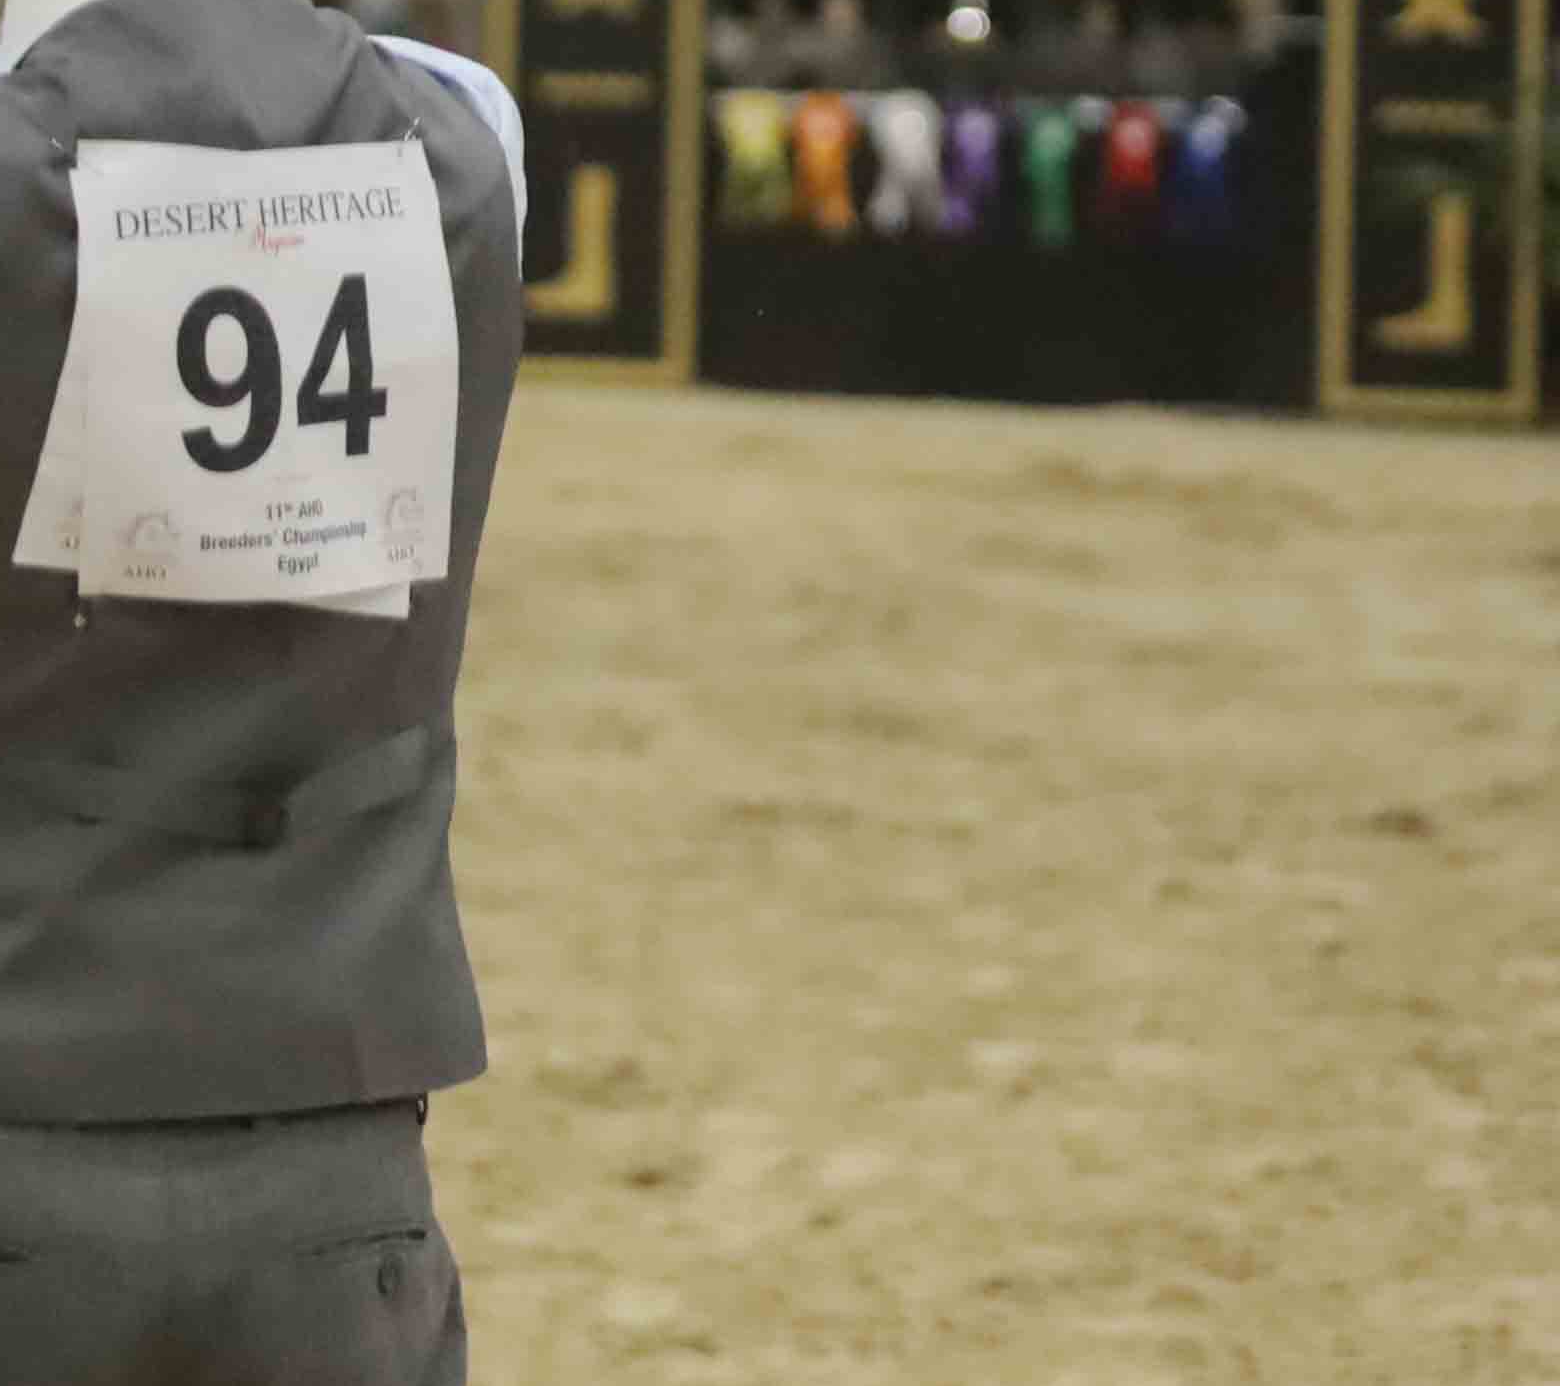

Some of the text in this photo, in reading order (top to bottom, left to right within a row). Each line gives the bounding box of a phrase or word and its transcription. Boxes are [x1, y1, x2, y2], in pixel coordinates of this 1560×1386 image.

[115, 186, 405, 240] DESERT HERITAGE
[176, 271, 387, 473] 94
[277, 551, 319, 576] Egypt
